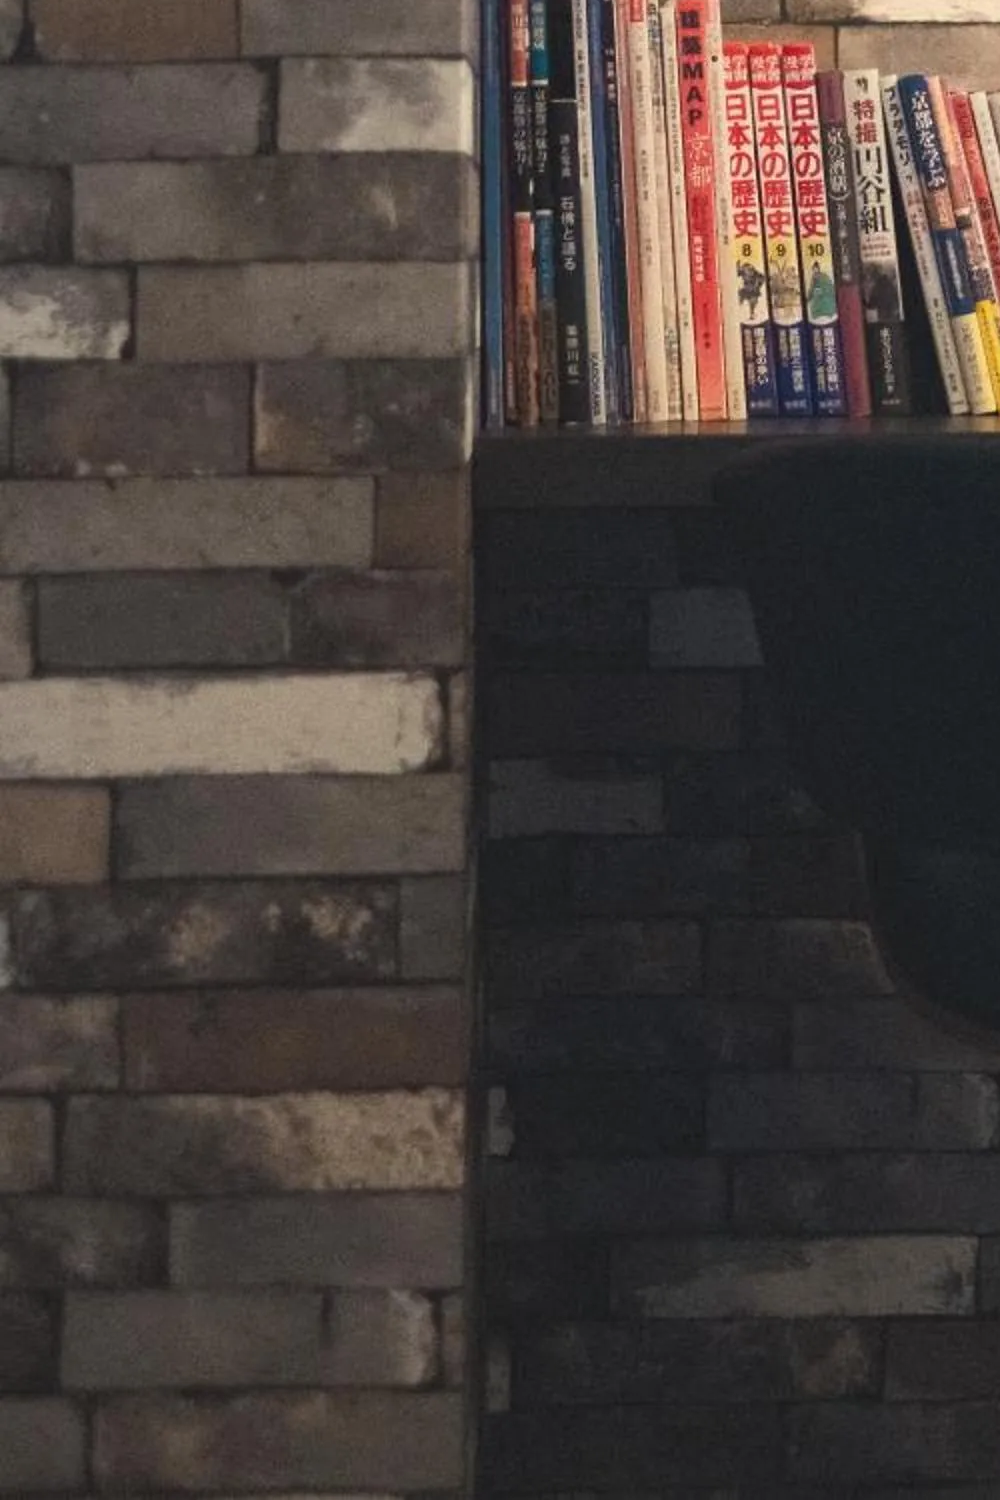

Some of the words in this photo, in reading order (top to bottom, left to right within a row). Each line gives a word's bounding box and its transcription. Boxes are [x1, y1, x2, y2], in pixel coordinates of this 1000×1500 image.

[726, 94, 759, 238] 日本の歴史
[757, 93, 792, 238] 日本の歴史
[791, 93, 828, 238] 日本の歴史
[885, 85, 911, 167] ブラタモリ
[741, 243, 753, 257] 8
[776, 243, 787, 257] 9
[807, 243, 825, 257] 10
